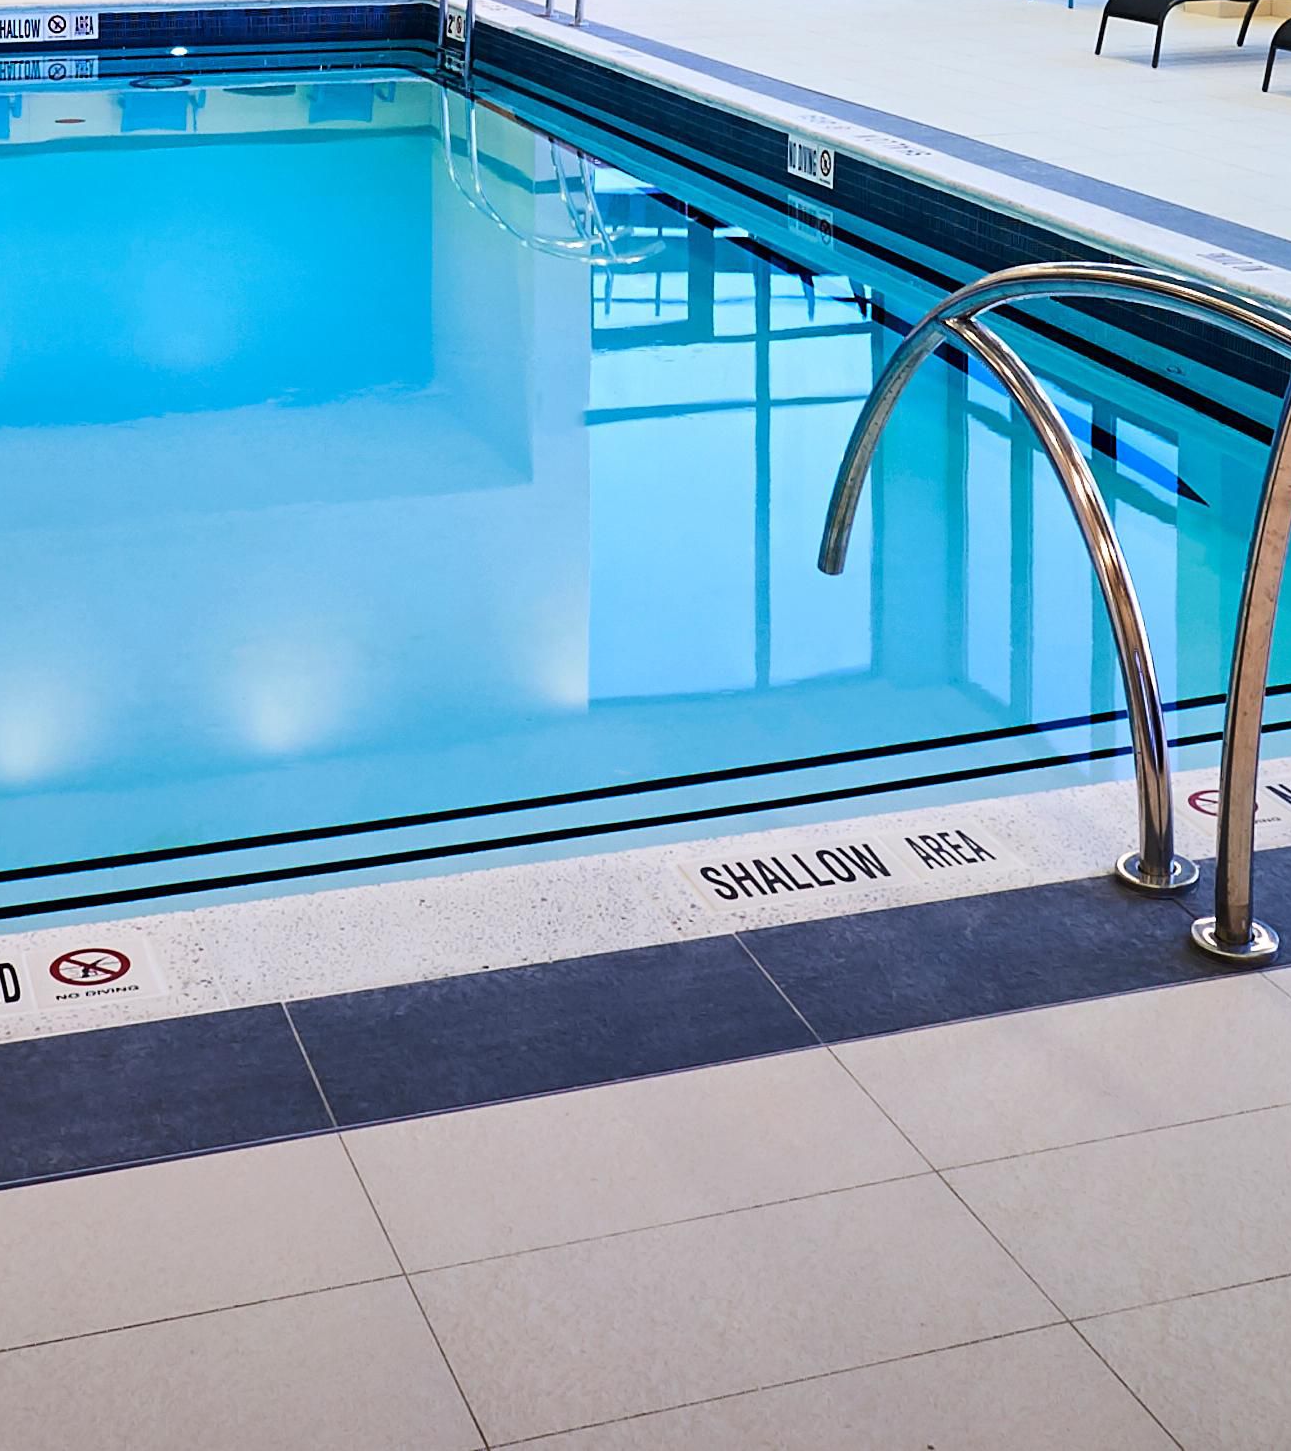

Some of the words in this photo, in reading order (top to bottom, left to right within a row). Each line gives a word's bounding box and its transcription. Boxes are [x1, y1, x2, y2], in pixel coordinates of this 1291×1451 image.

[699, 843, 892, 900] SHALLOW
[904, 830, 997, 869] AREA
[55, 992, 80, 1001] NO
